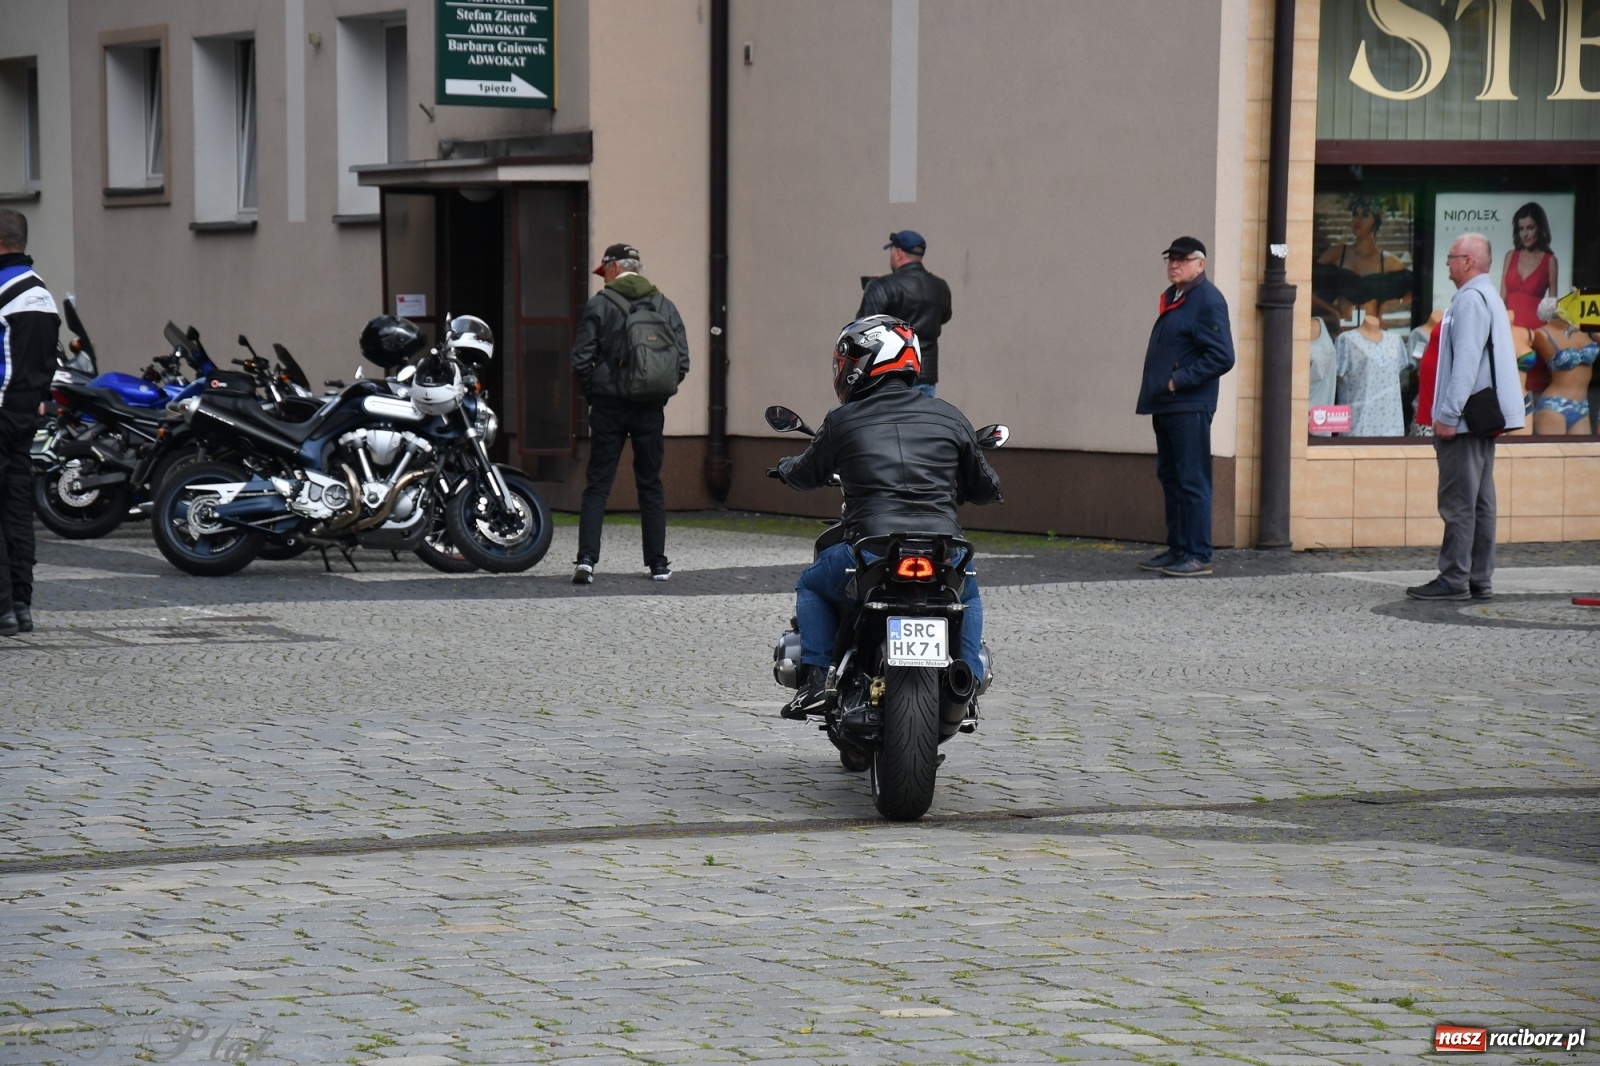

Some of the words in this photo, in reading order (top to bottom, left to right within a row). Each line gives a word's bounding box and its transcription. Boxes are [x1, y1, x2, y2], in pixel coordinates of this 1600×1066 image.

[457, 8, 492, 21] Stefan
[495, 10, 537, 23] Zientek
[468, 23, 527, 36] ADWOKAT
[448, 39, 495, 53] Barbara
[497, 41, 546, 55] Gniewek
[468, 54, 527, 67] ADWOKAT
[1444, 209, 1500, 222] NIPPLEX
[891, 631, 900, 639] PL
[903, 623, 935, 638] SRC
[893, 641, 940, 657] HK71
